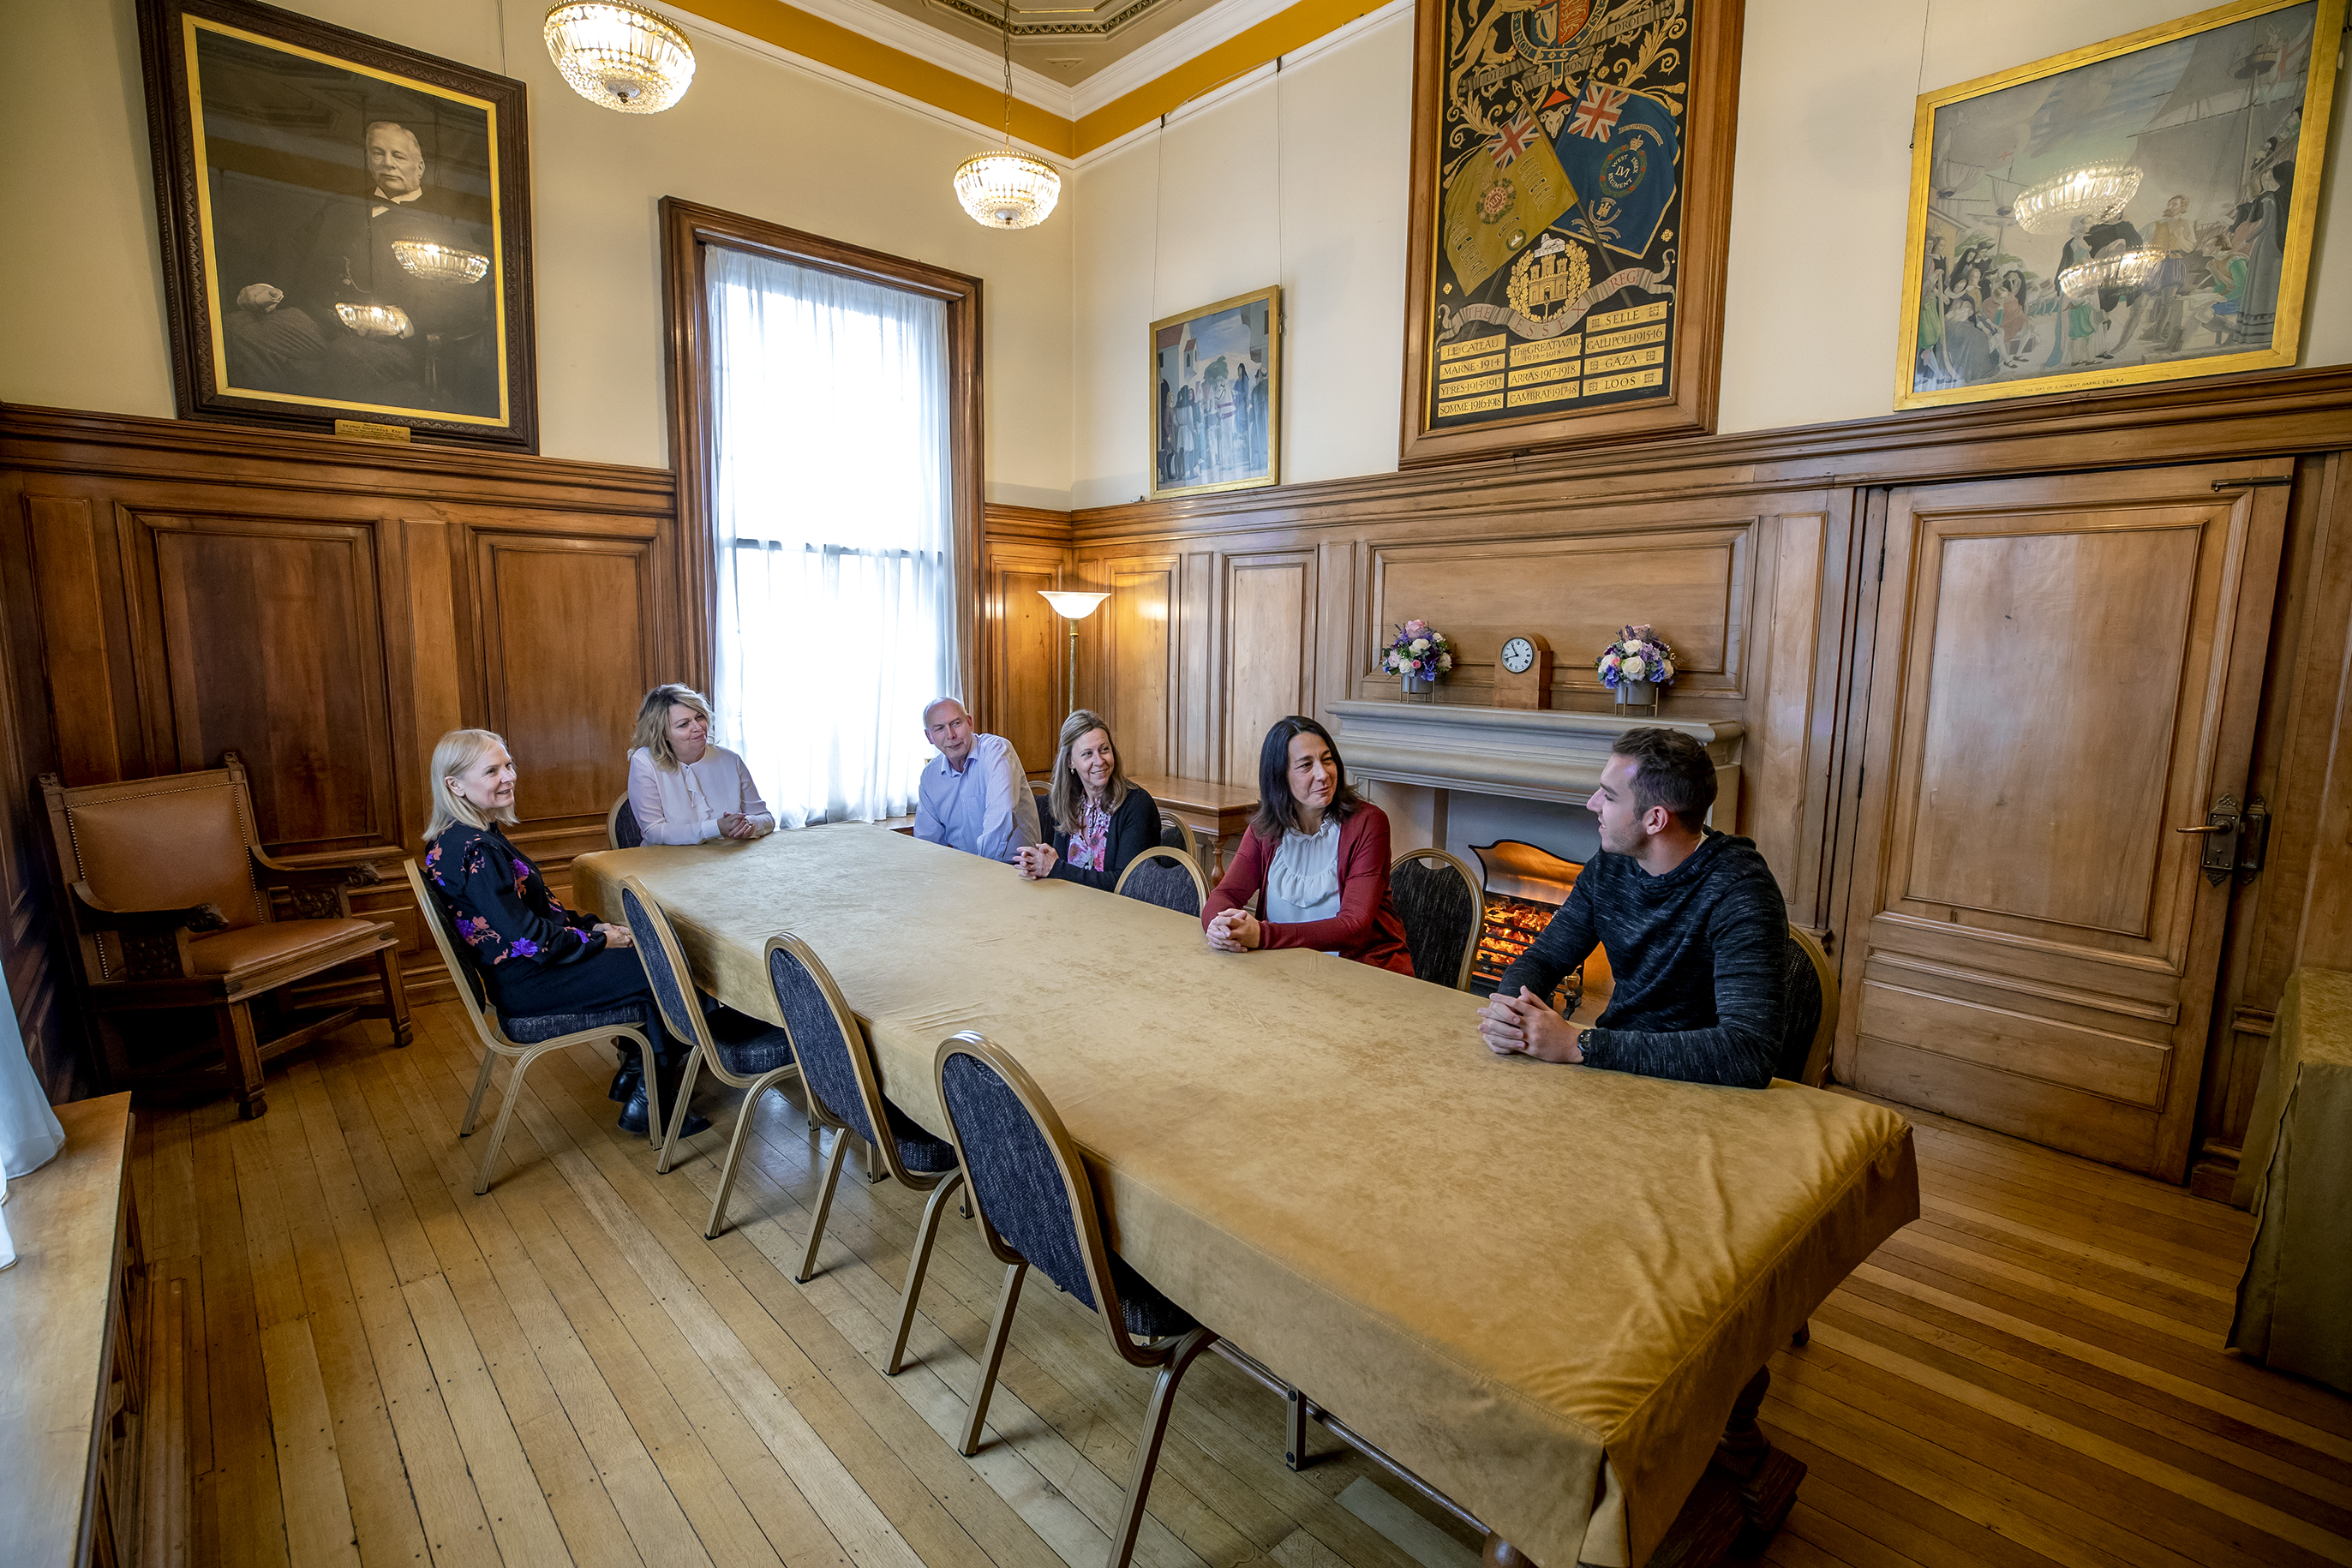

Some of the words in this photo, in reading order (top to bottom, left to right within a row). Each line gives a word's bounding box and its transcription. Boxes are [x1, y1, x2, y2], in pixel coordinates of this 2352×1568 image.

[1614, 13, 1648, 34] DROIT
[1513, 27, 1533, 56] HONI
[1486, 66, 1511, 82] DIEU
[1612, 154, 1629, 168] WEST
[1631, 157, 1640, 174] ESSEX
[1608, 172, 1632, 189] REGIMENT
[1467, 306, 1491, 320] THE
[1514, 305, 1586, 337] ESSEX
[1606, 310, 1640, 326] SELLE
[1605, 355, 1637, 368] GAZA
[1605, 376, 1636, 390] LOOS
